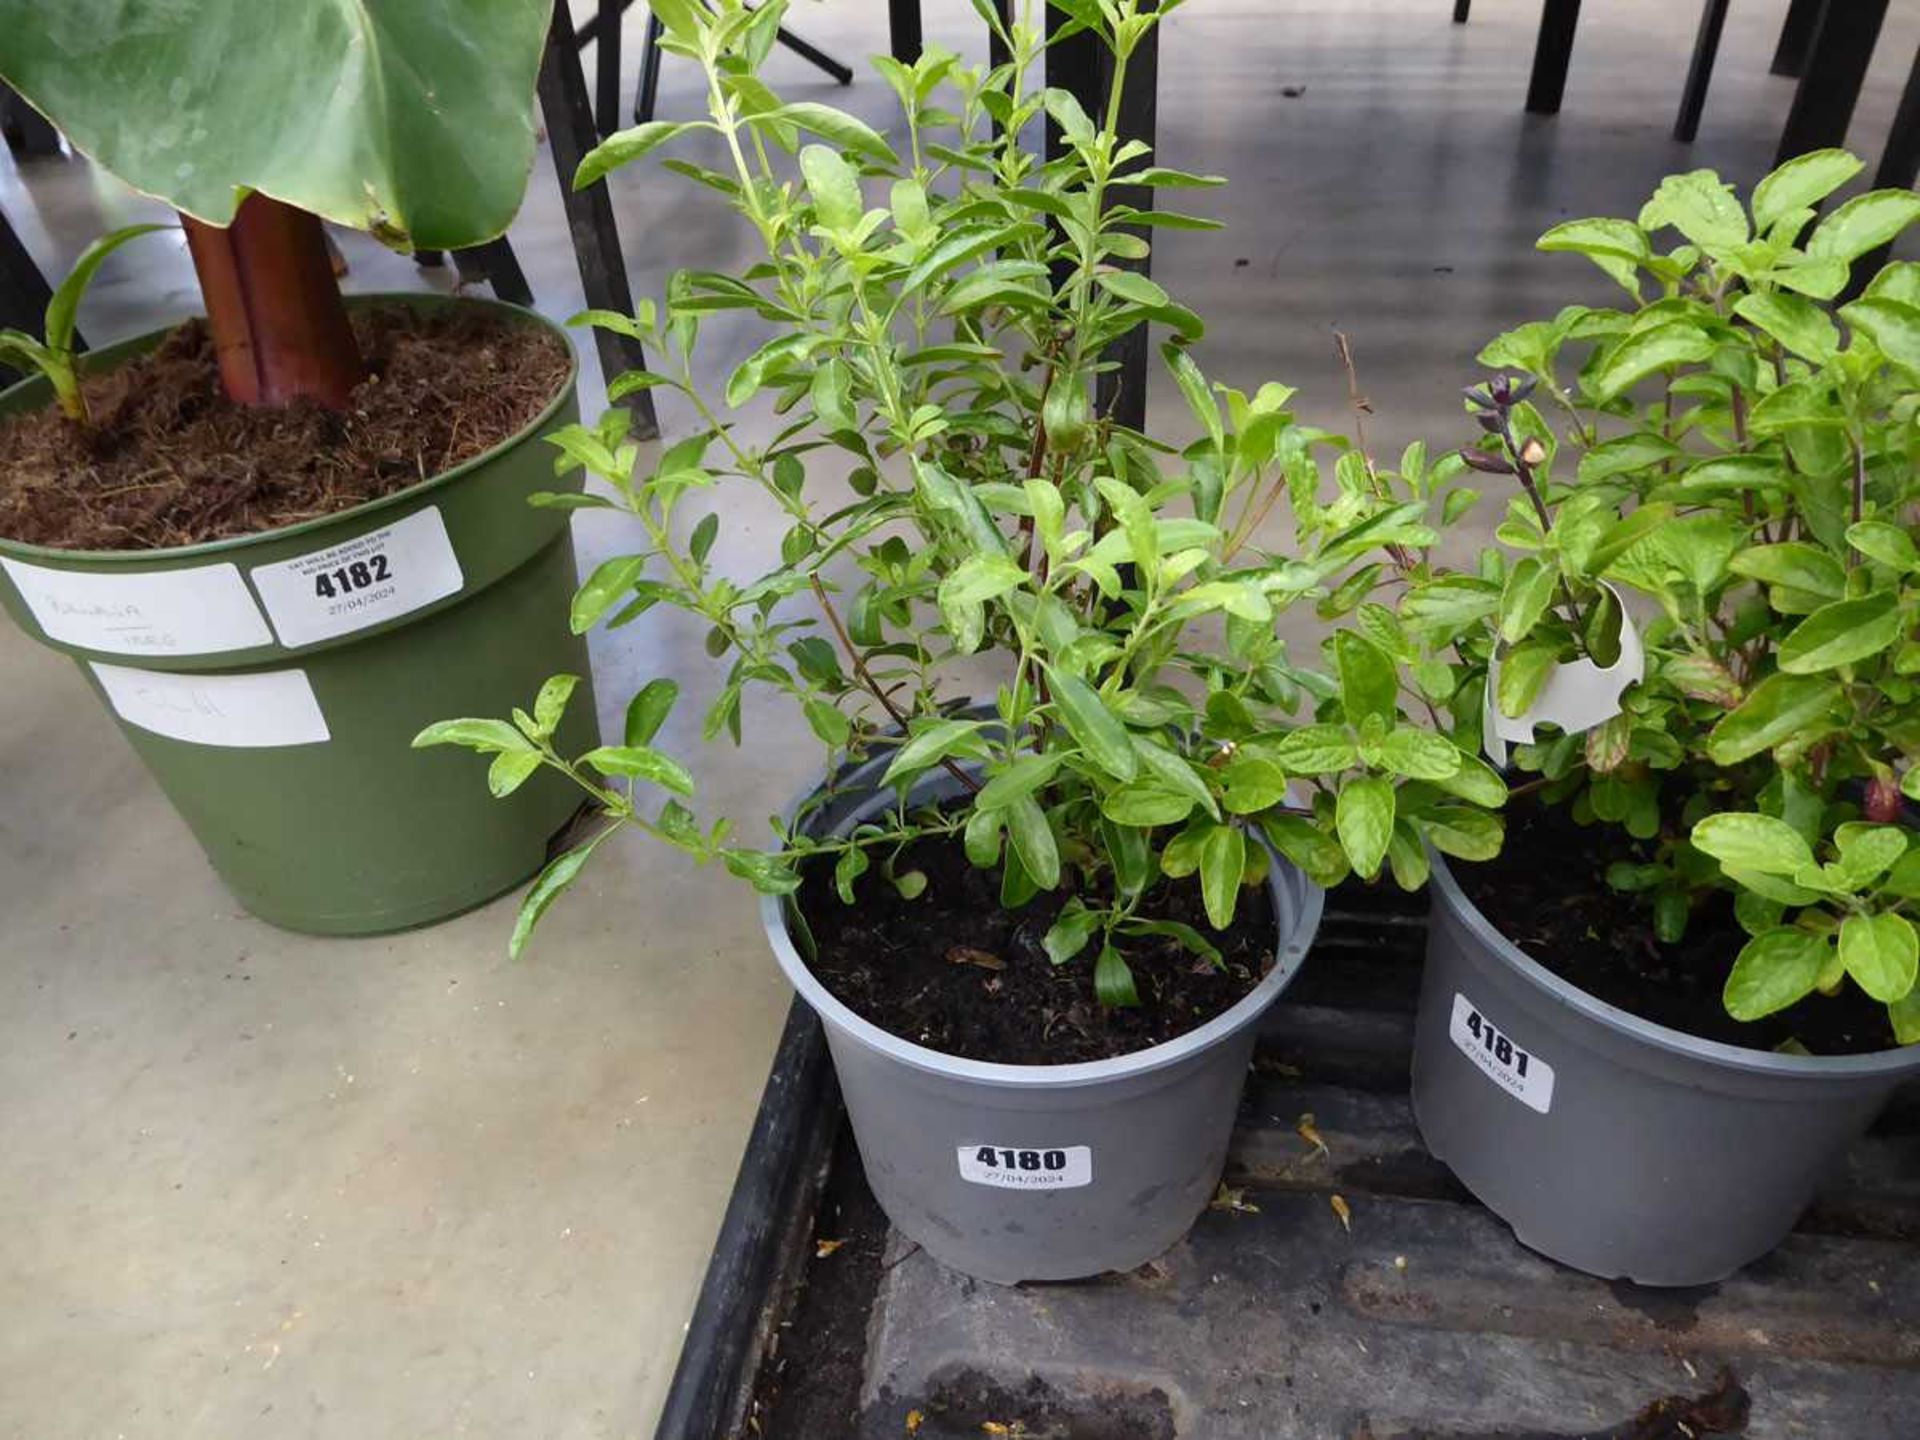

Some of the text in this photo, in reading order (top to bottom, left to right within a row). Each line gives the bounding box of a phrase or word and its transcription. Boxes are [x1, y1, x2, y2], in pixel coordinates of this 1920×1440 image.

[316, 554, 392, 598] 4182
[328, 586, 395, 615] 27/04/2024
[1467, 1010, 1528, 1078] 4181
[1464, 1041, 1524, 1092] 27/04/2024
[976, 1147, 1066, 1170] 4180
[985, 1172, 1063, 1184] 27/04/2024
